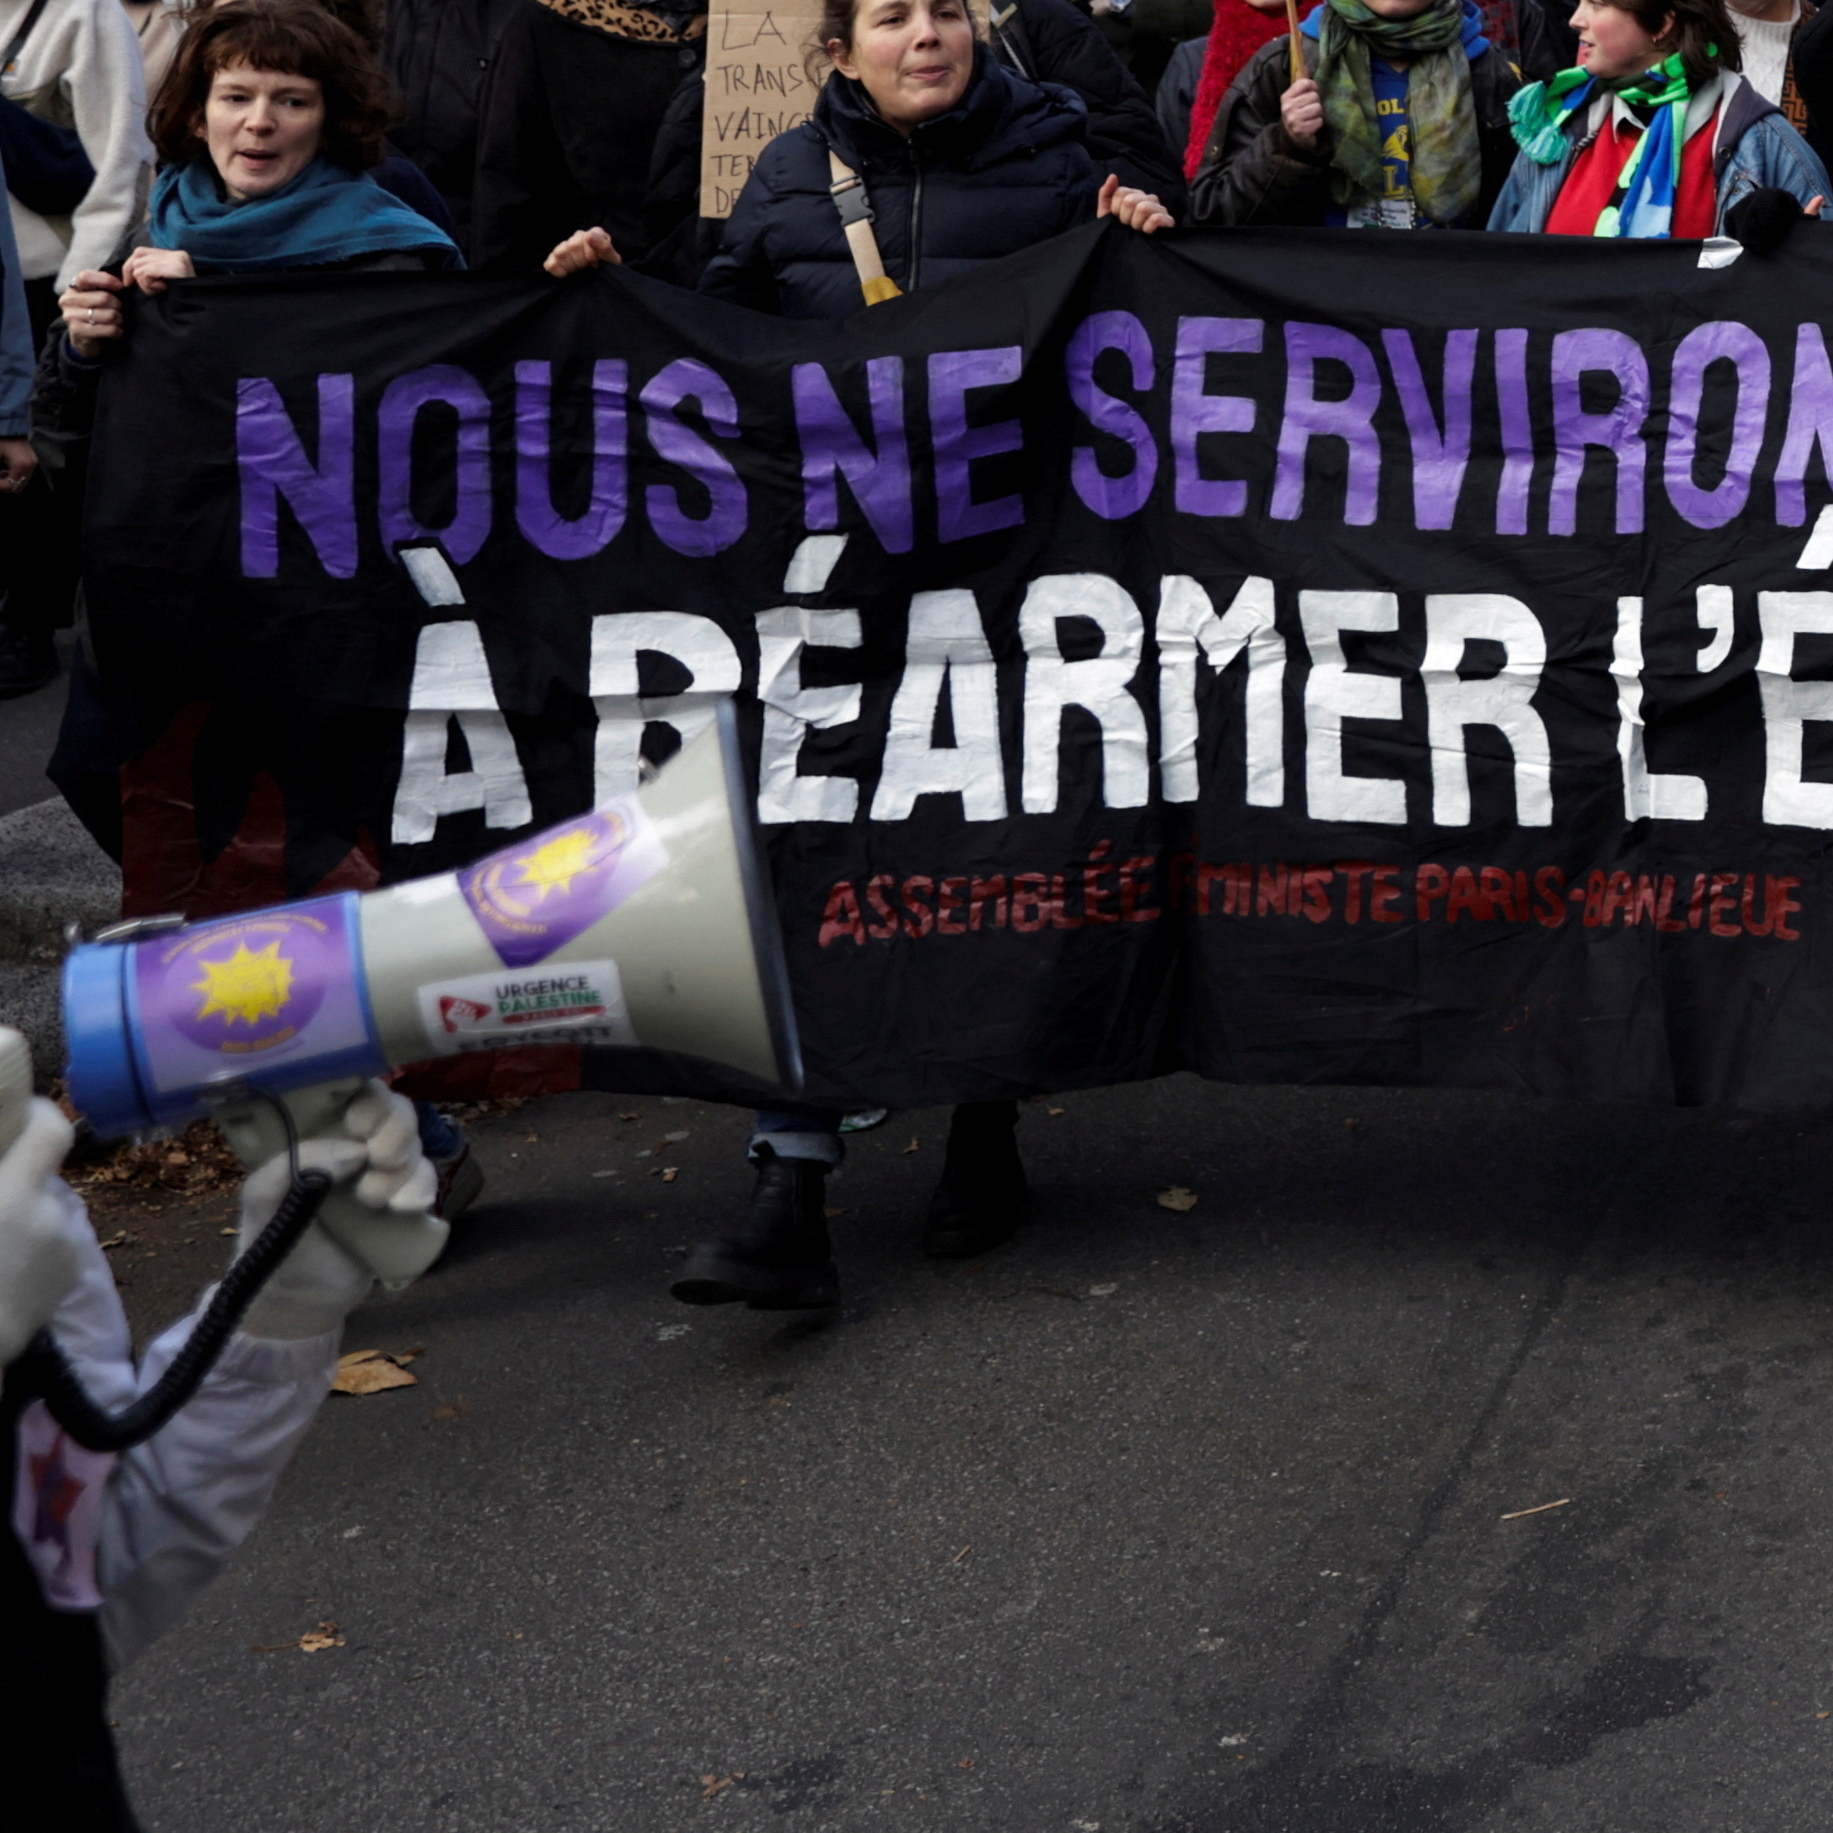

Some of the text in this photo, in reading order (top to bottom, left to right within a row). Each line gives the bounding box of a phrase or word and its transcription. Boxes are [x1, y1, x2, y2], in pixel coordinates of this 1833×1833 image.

[722, 9, 786, 50] LA
[235, 357, 748, 580] NOUS
[792, 346, 1025, 555] NE
[391, 546, 532, 845] À
[590, 533, 1553, 826] RÉARMER
[818, 837, 1803, 948] ASSEMBLÉE PARIS-BANLIEUE
[496, 976, 589, 999] URGENCE
[500, 990, 602, 1013] PALESTINE
